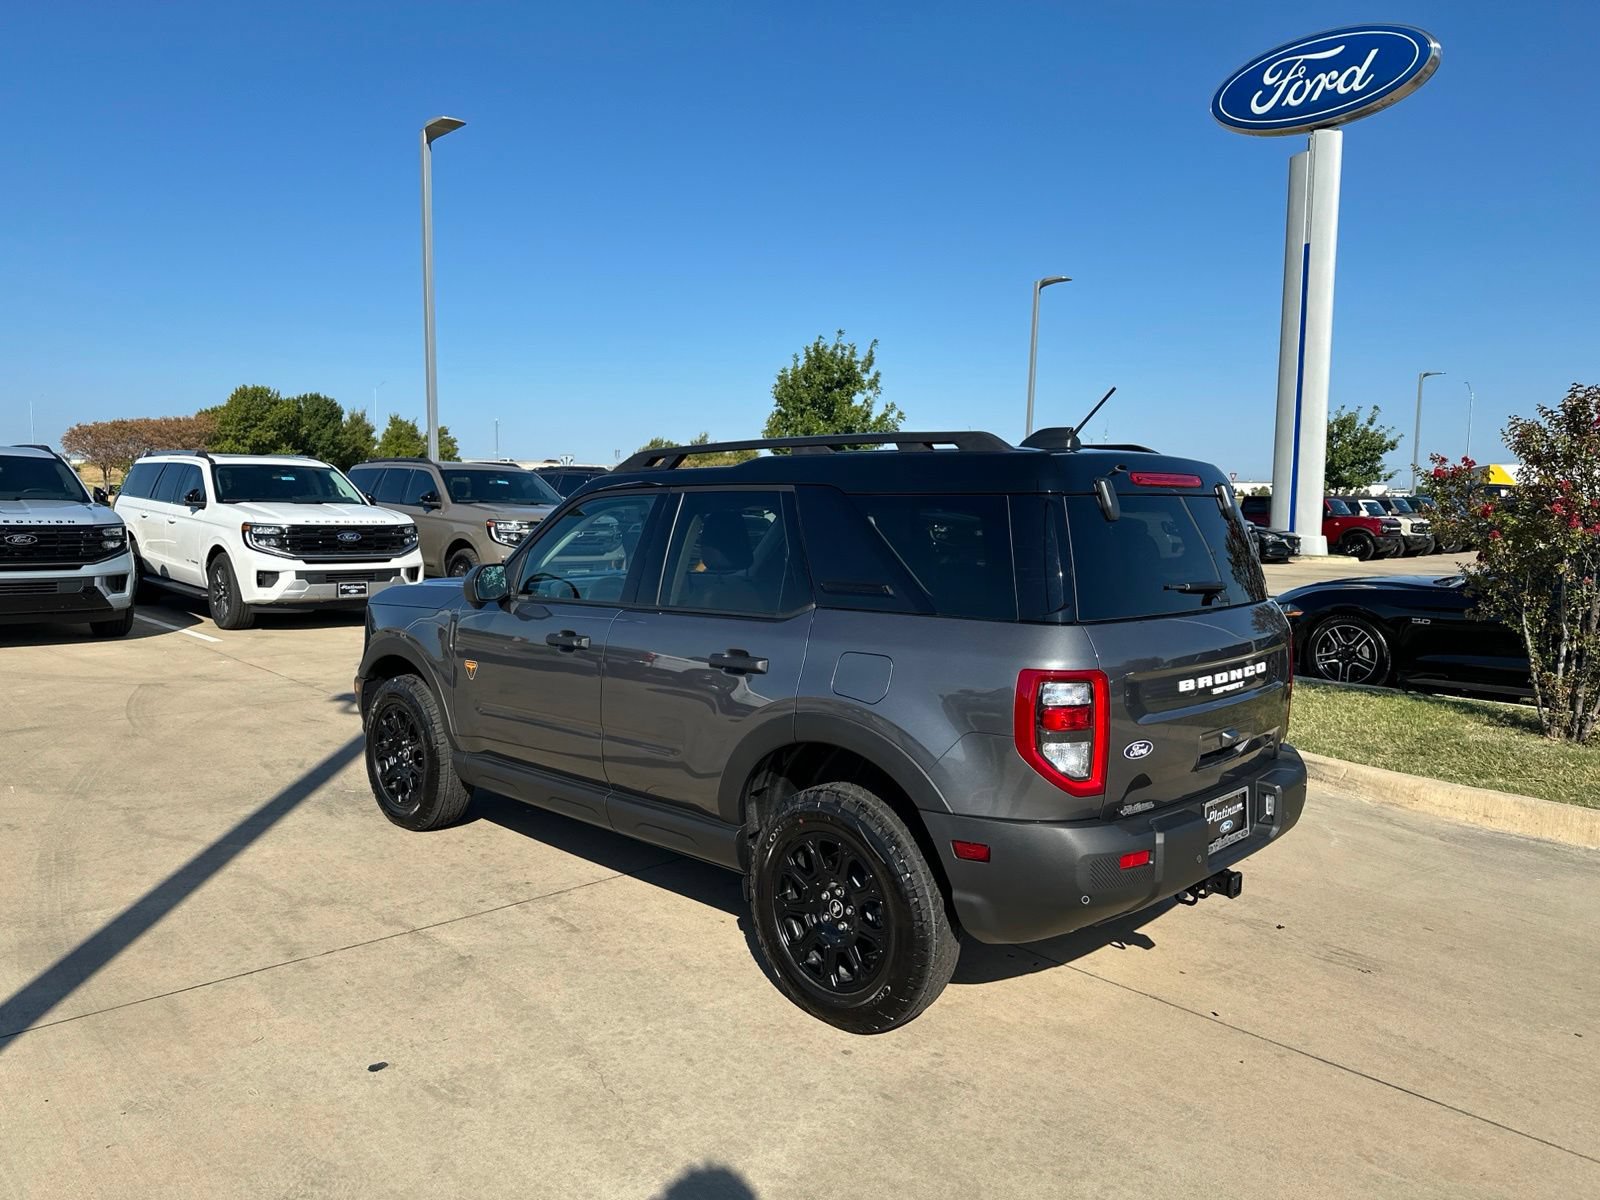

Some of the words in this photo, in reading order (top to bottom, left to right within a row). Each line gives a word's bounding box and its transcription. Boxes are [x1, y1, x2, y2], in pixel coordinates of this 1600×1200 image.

[1250, 44, 1379, 115] Ford
[11, 534, 32, 543] Ford
[1178, 661, 1267, 693] BRONCO
[1211, 680, 1246, 695] SPORT
[1130, 743, 1149, 757] Ford
[1206, 802, 1245, 825] Platinum
